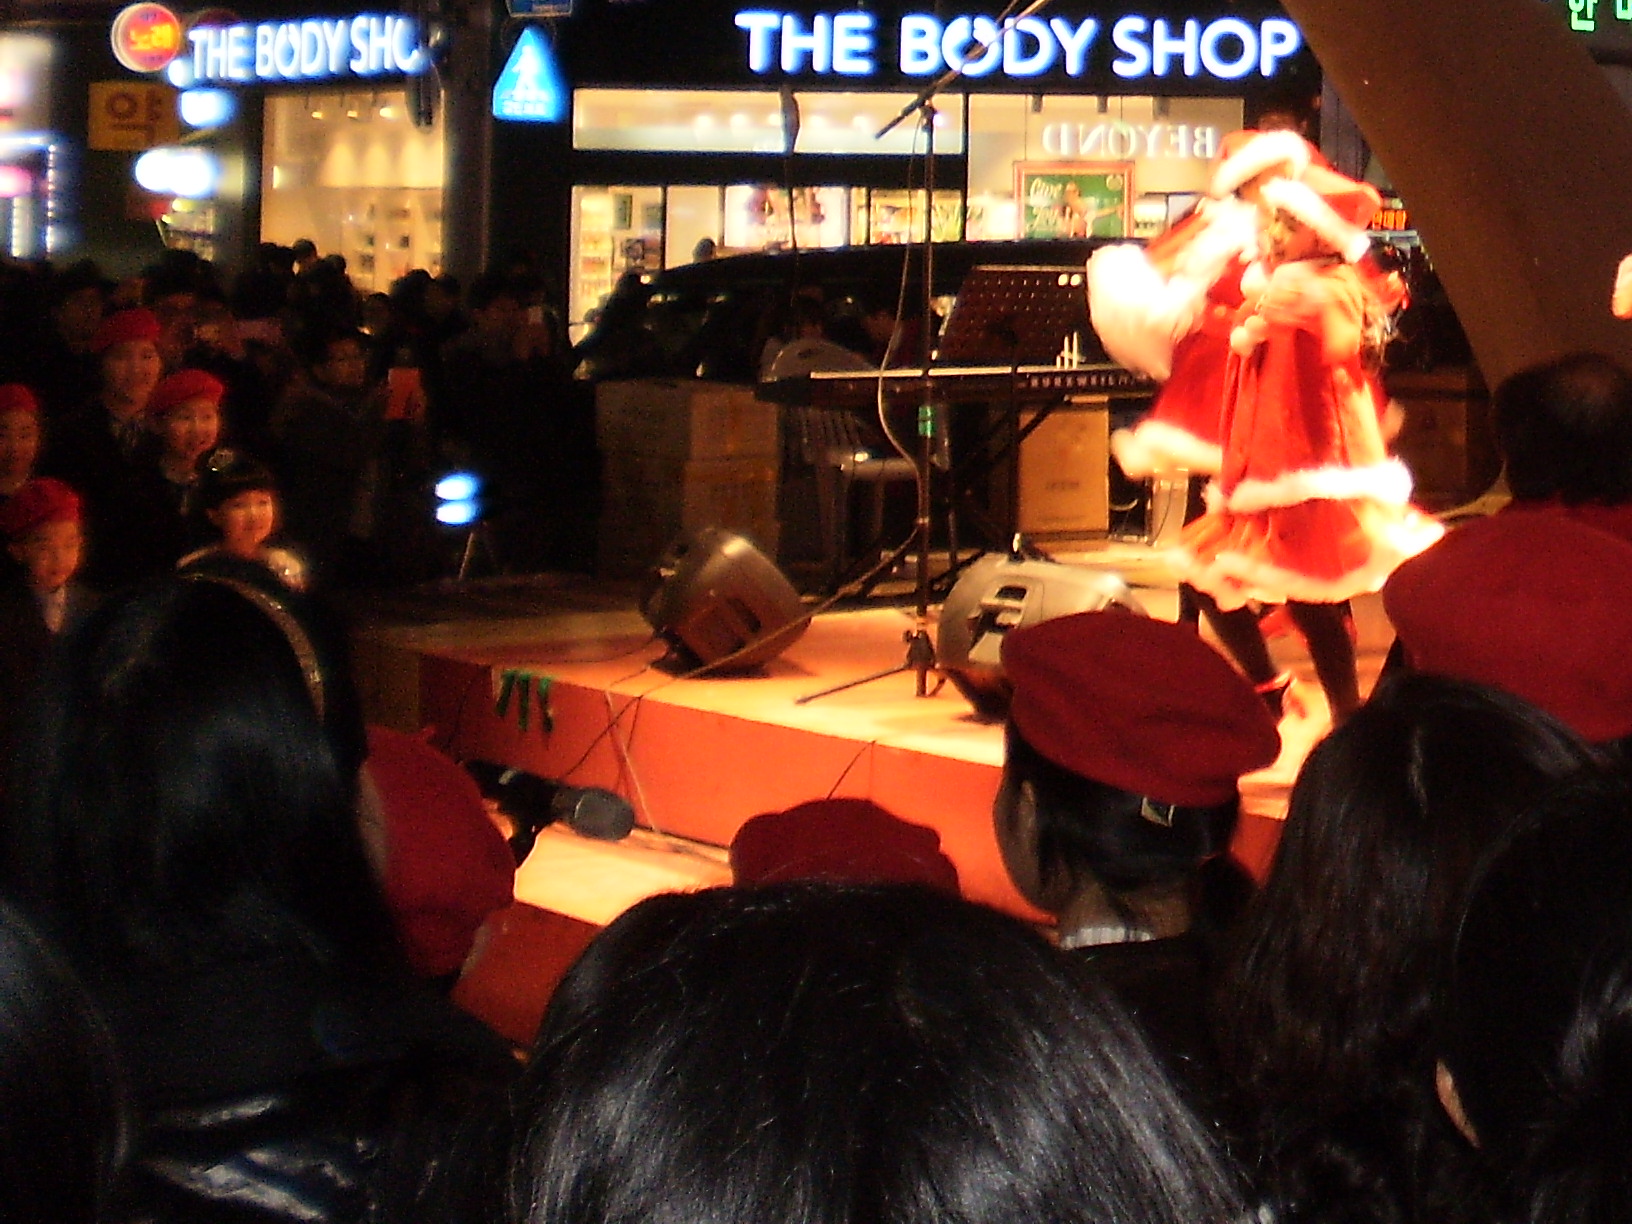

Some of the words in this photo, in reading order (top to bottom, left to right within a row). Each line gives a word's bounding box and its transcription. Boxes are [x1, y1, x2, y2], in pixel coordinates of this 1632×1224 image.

[188, 24, 250, 80] THE
[254, 18, 347, 79] BODY
[349, 15, 421, 75] SHO
[734, 11, 875, 74] THE
[900, 14, 1097, 77] BODY
[1112, 16, 1300, 79] SHOP
